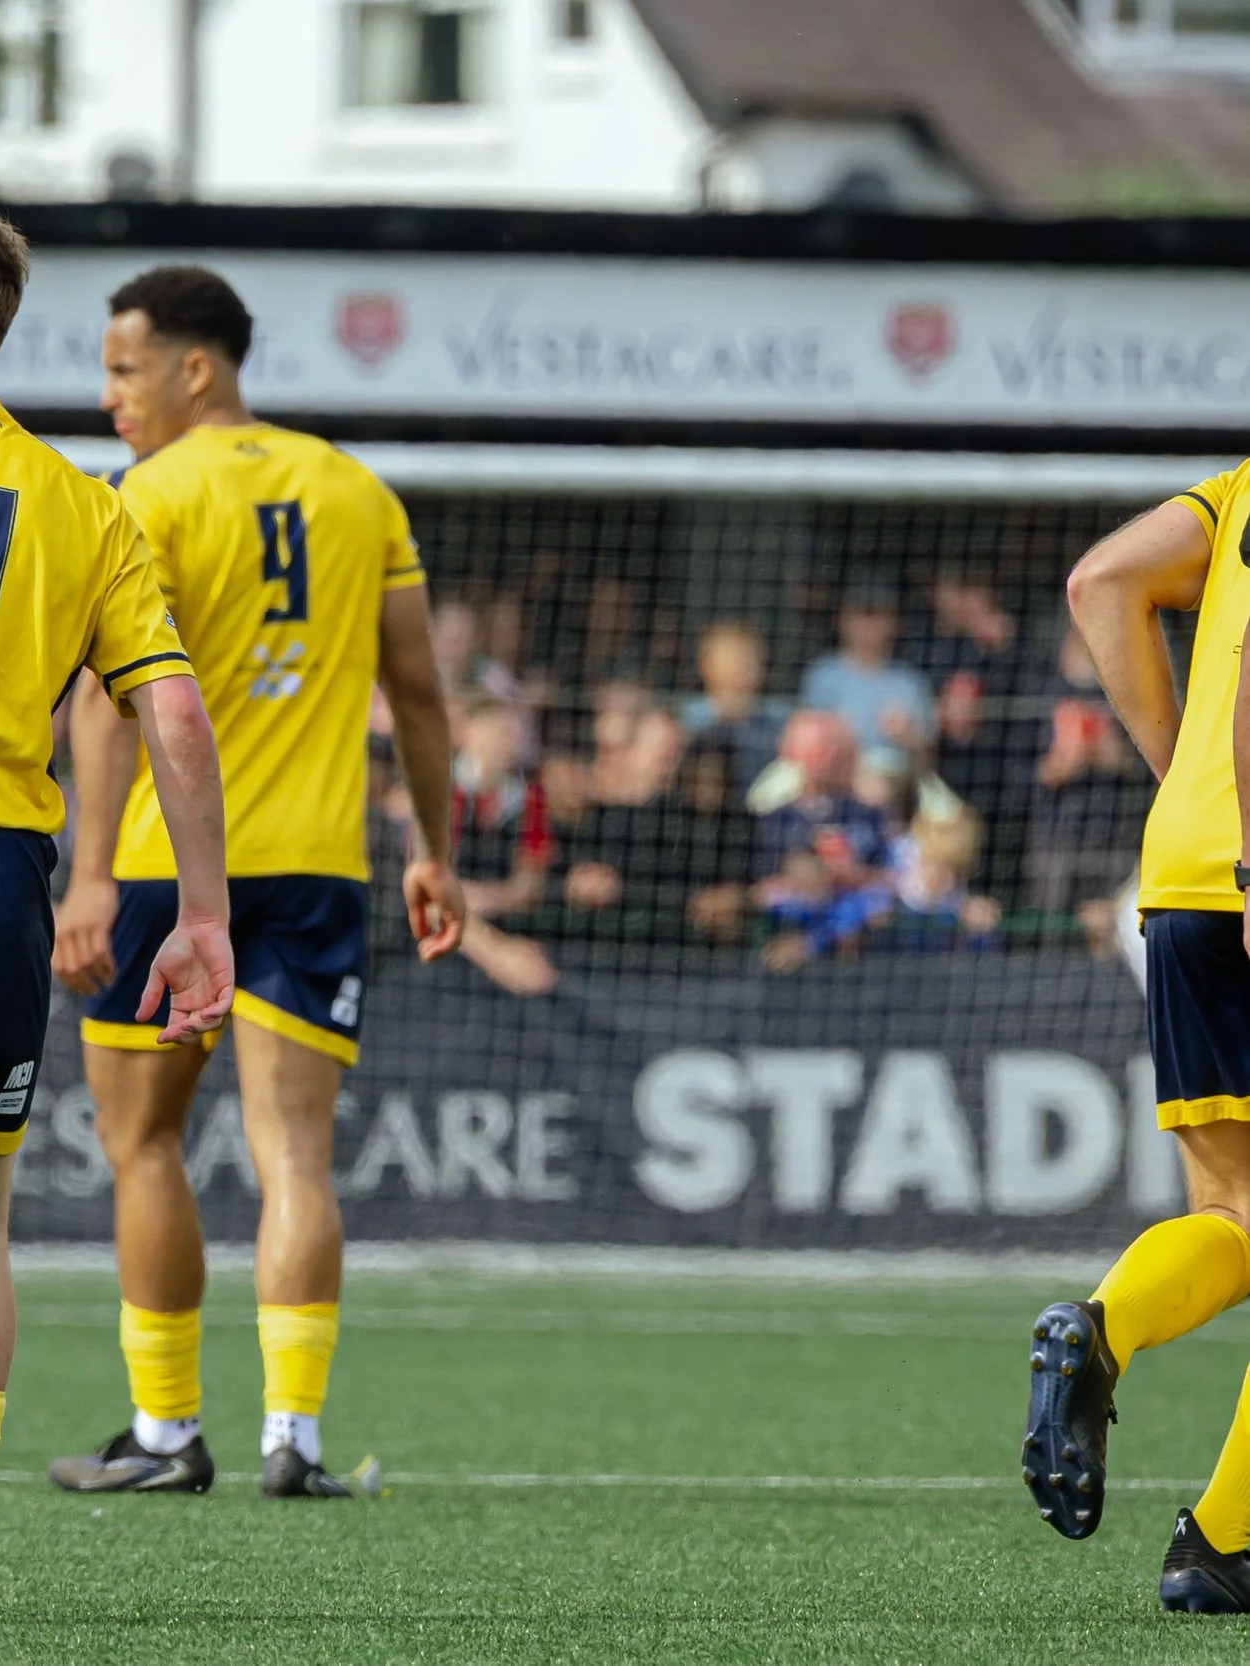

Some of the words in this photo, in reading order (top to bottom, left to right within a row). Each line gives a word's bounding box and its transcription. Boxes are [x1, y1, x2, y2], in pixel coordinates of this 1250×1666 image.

[988, 300, 1250, 400] VESTAC
[252, 499, 310, 624] 9
[632, 1047, 1190, 1215] STADI
